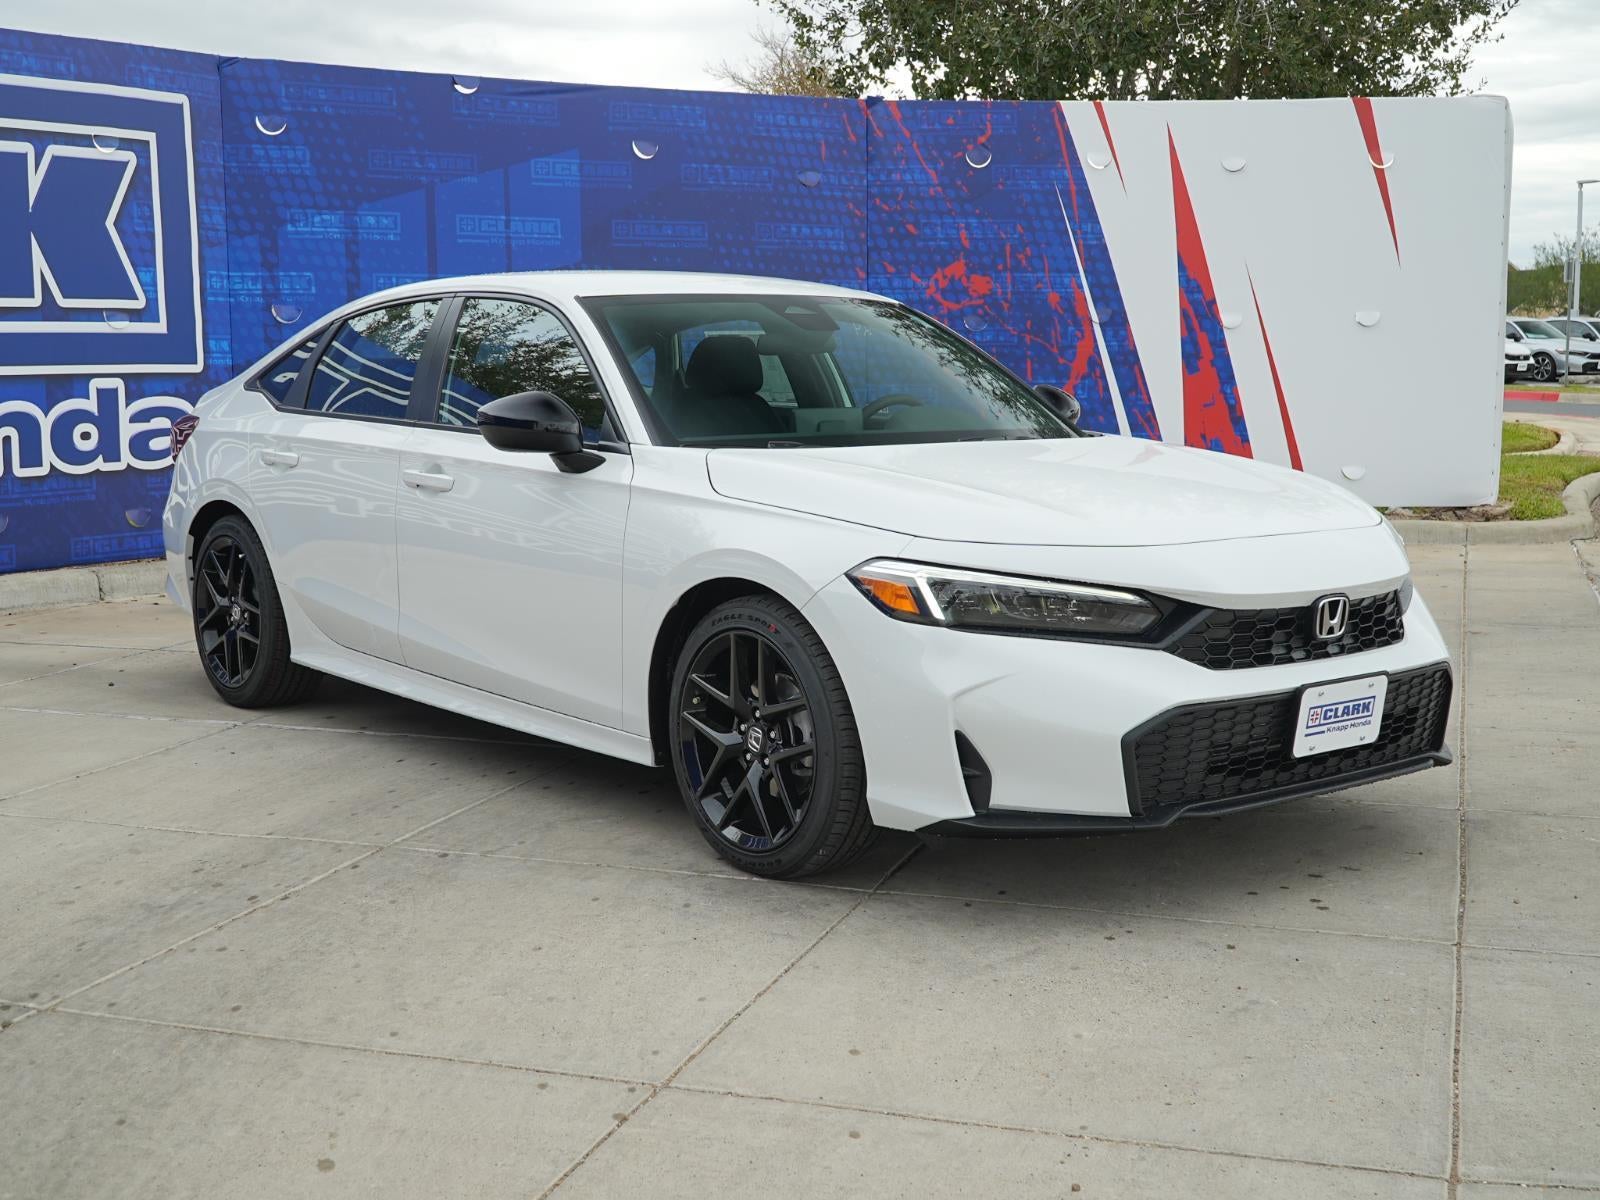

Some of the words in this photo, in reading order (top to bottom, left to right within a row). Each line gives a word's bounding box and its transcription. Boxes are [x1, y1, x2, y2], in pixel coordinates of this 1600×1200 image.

[1322, 700, 1373, 721] CLARK
[1326, 723, 1349, 734] Knapp
[1349, 719, 1372, 729] Honda
